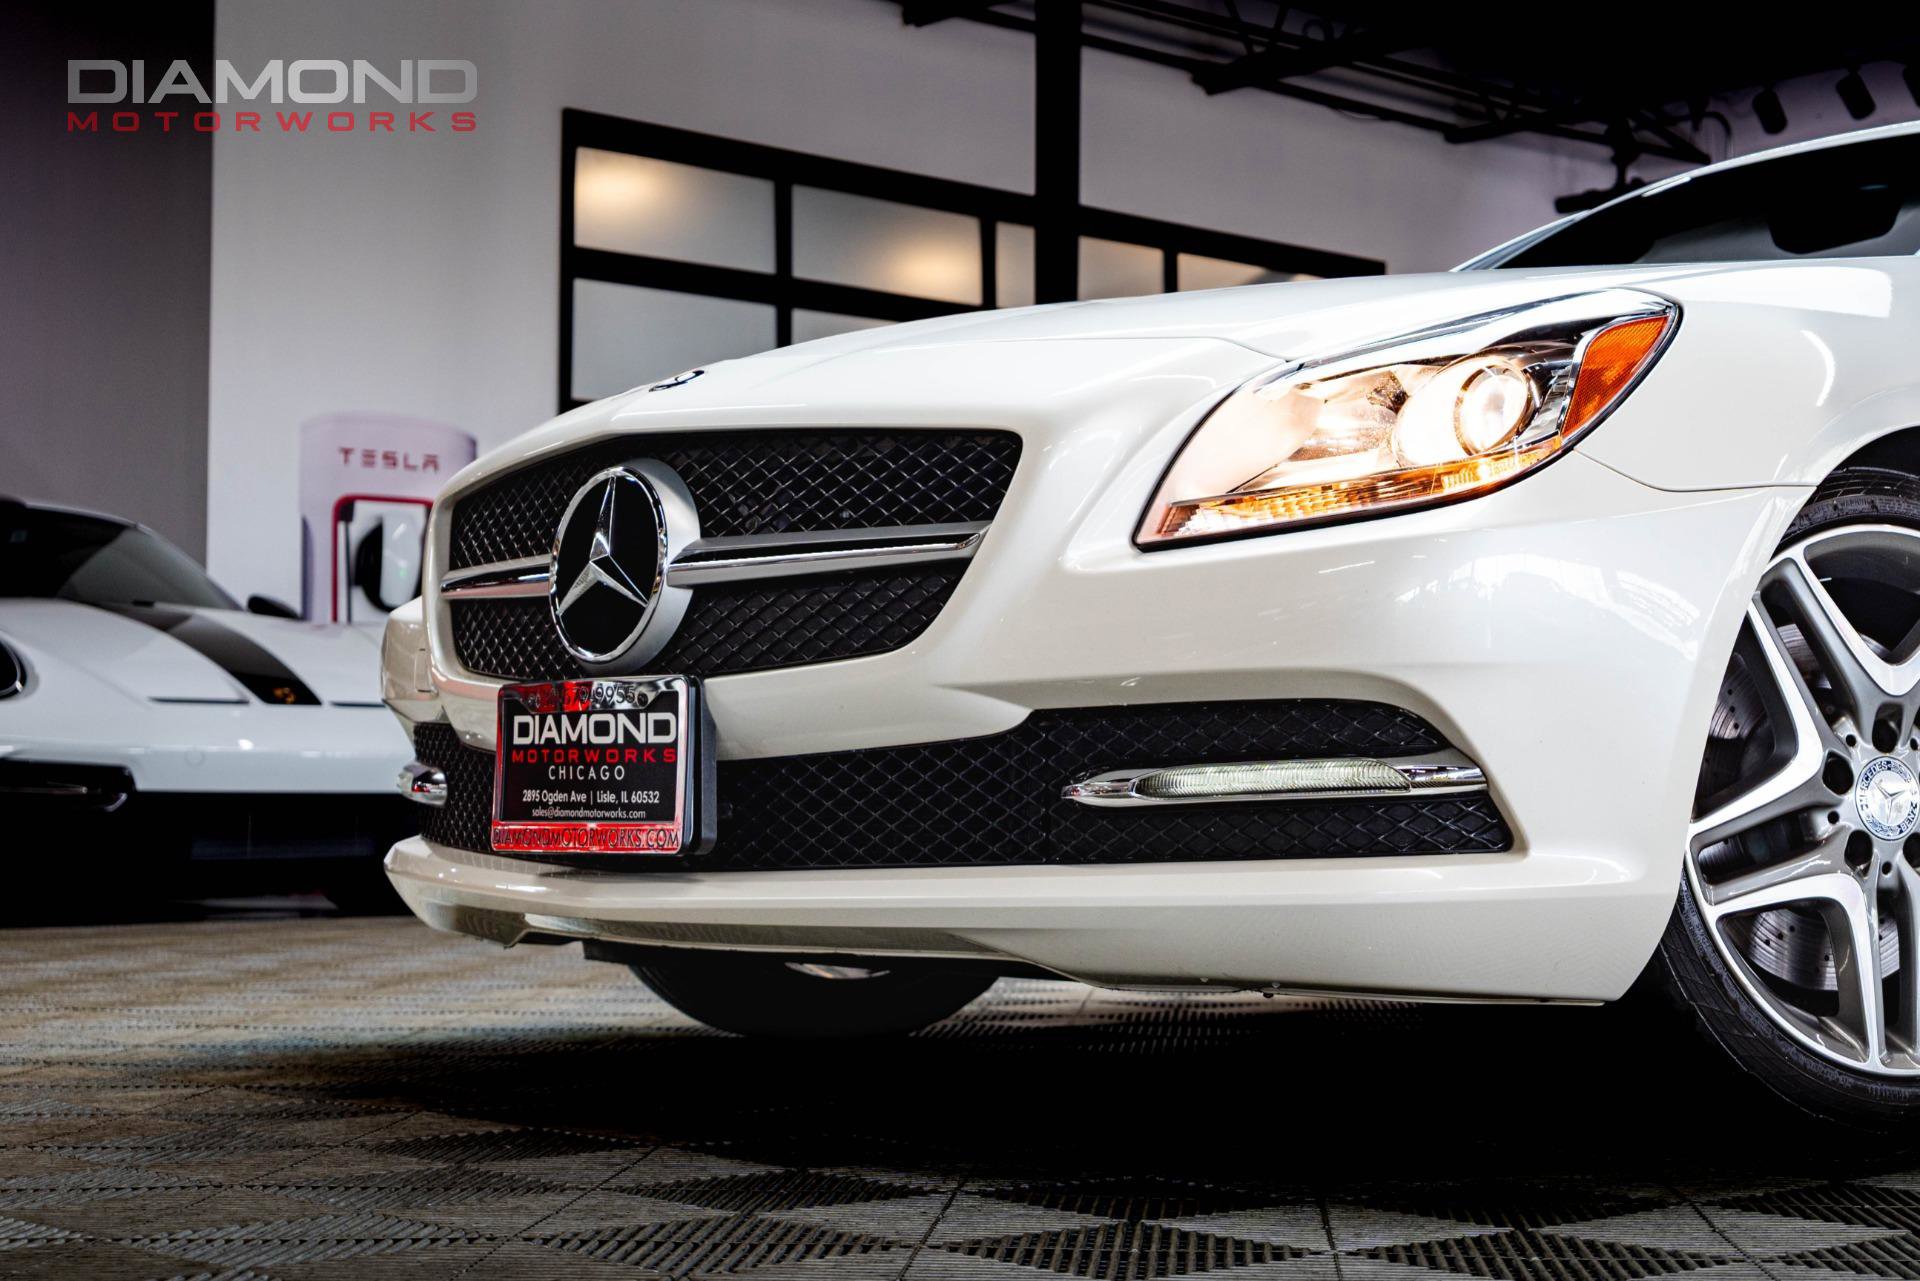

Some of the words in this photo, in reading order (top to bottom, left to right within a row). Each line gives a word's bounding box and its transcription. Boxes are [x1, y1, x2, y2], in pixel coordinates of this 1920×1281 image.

[338, 447, 440, 471] TESLA
[512, 712, 677, 745] DIAMOND
[511, 748, 677, 764] MOTORWORKS
[548, 765, 626, 781] CHICAGO
[522, 791, 540, 802] 2895
[541, 790, 568, 804] Ogden
[570, 791, 587, 803] Ave
[597, 791, 619, 804] Lisle,
[621, 791, 629, 804] IL
[631, 790, 660, 804] 60532
[532, 806, 647, 819] sales@diamondmotorworks.com
[492, 827, 681, 849] DIAMONDMOTORWORKS.COM
